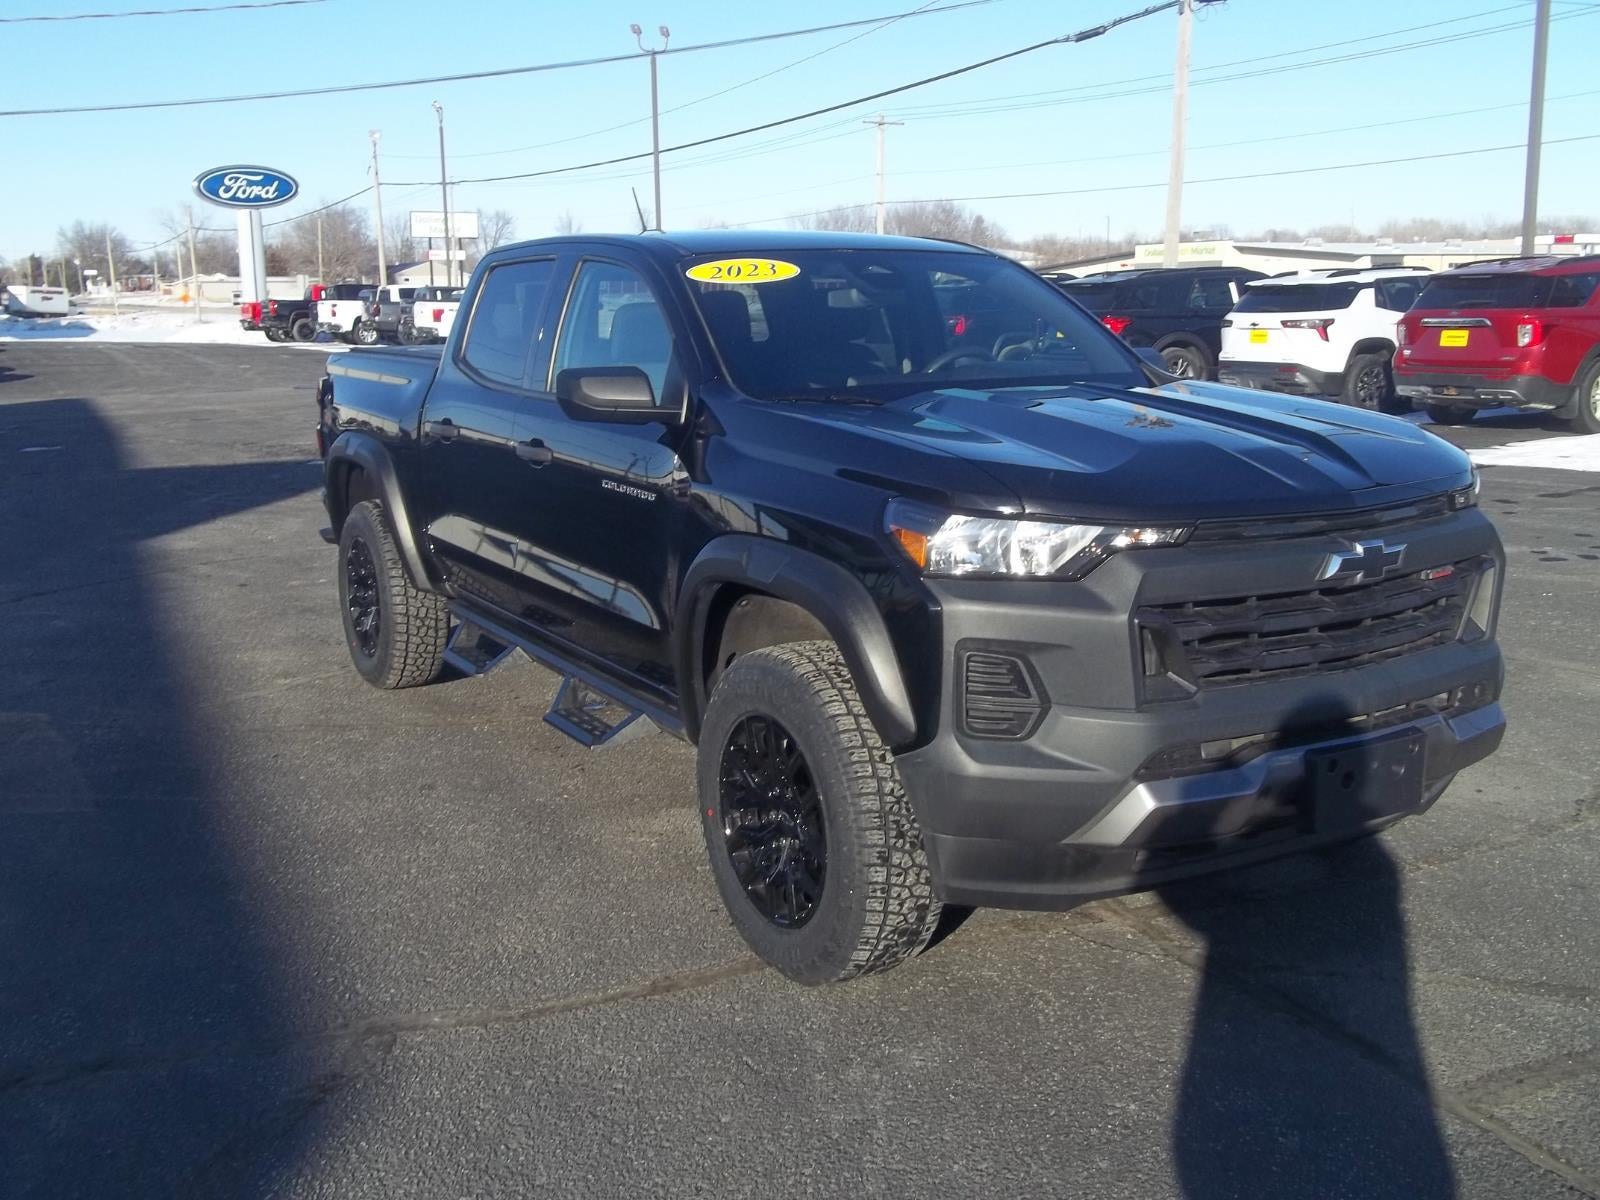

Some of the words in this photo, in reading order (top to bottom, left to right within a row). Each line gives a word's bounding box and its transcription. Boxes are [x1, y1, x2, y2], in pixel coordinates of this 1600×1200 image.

[218, 173, 279, 199] Ford
[710, 263, 777, 279] 2023
[601, 479, 657, 501] COLORADO
